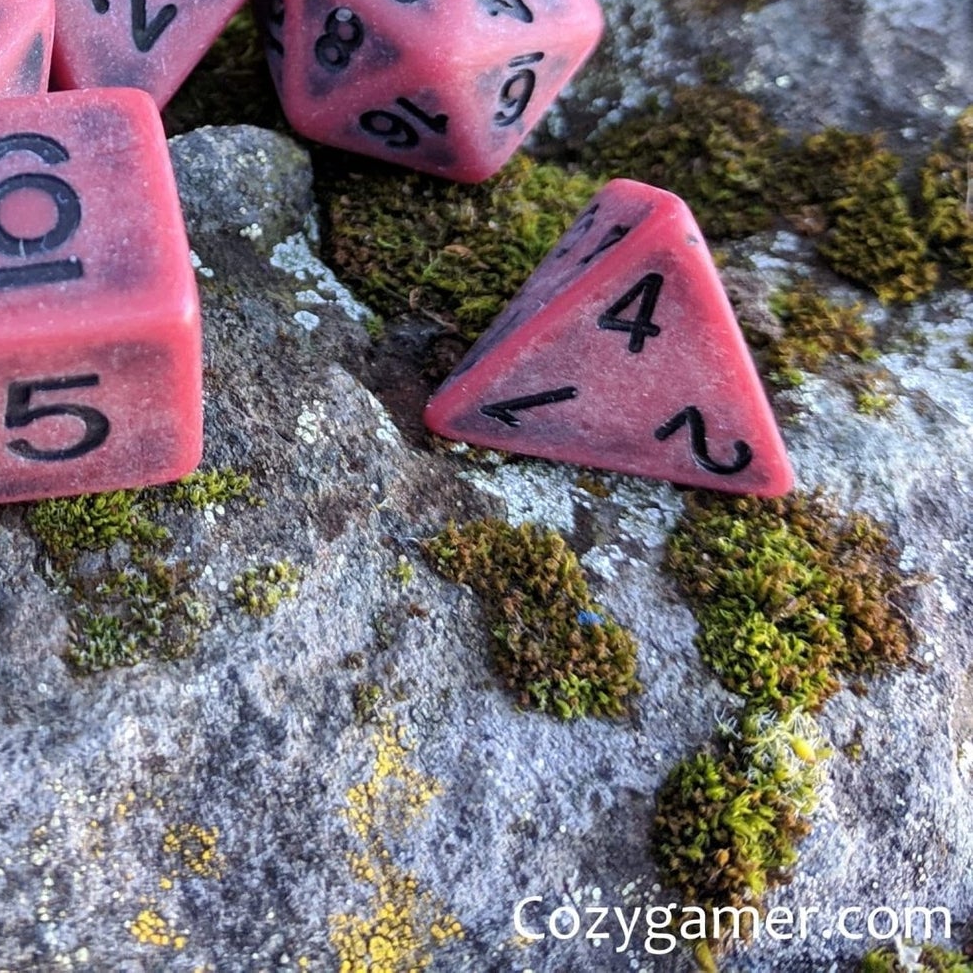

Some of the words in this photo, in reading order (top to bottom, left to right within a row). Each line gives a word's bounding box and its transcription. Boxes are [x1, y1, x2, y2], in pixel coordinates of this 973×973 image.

[314, 7, 364, 74] 8
[360, 97, 449, 148] 16
[598, 273, 663, 353] 4
[4, 373, 110, 460] 5
[480, 386, 577, 426] 1
[654, 406, 753, 475] 2
